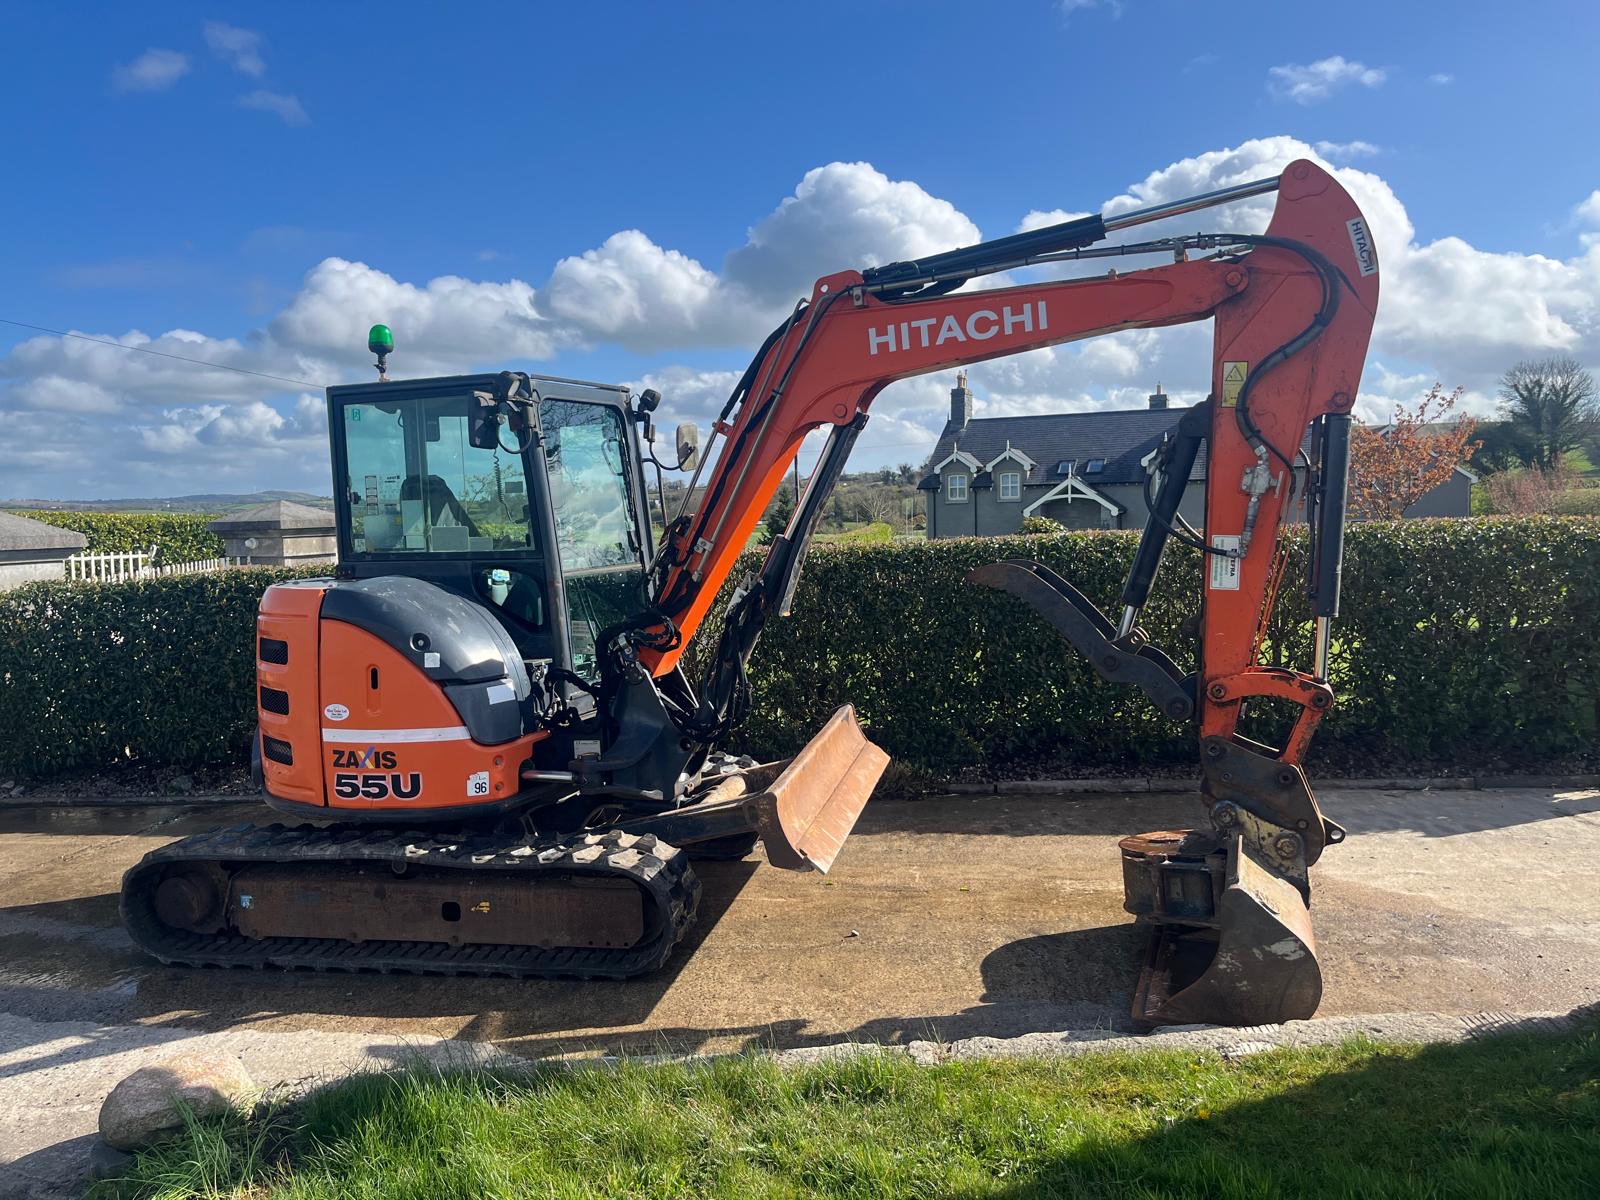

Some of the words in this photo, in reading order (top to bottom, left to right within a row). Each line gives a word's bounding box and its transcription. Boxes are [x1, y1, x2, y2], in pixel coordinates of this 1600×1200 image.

[868, 301, 1048, 355] HITACHI
[332, 746, 397, 770] ZAXIS
[335, 772, 421, 800] 55U
[474, 782, 487, 794] 96
